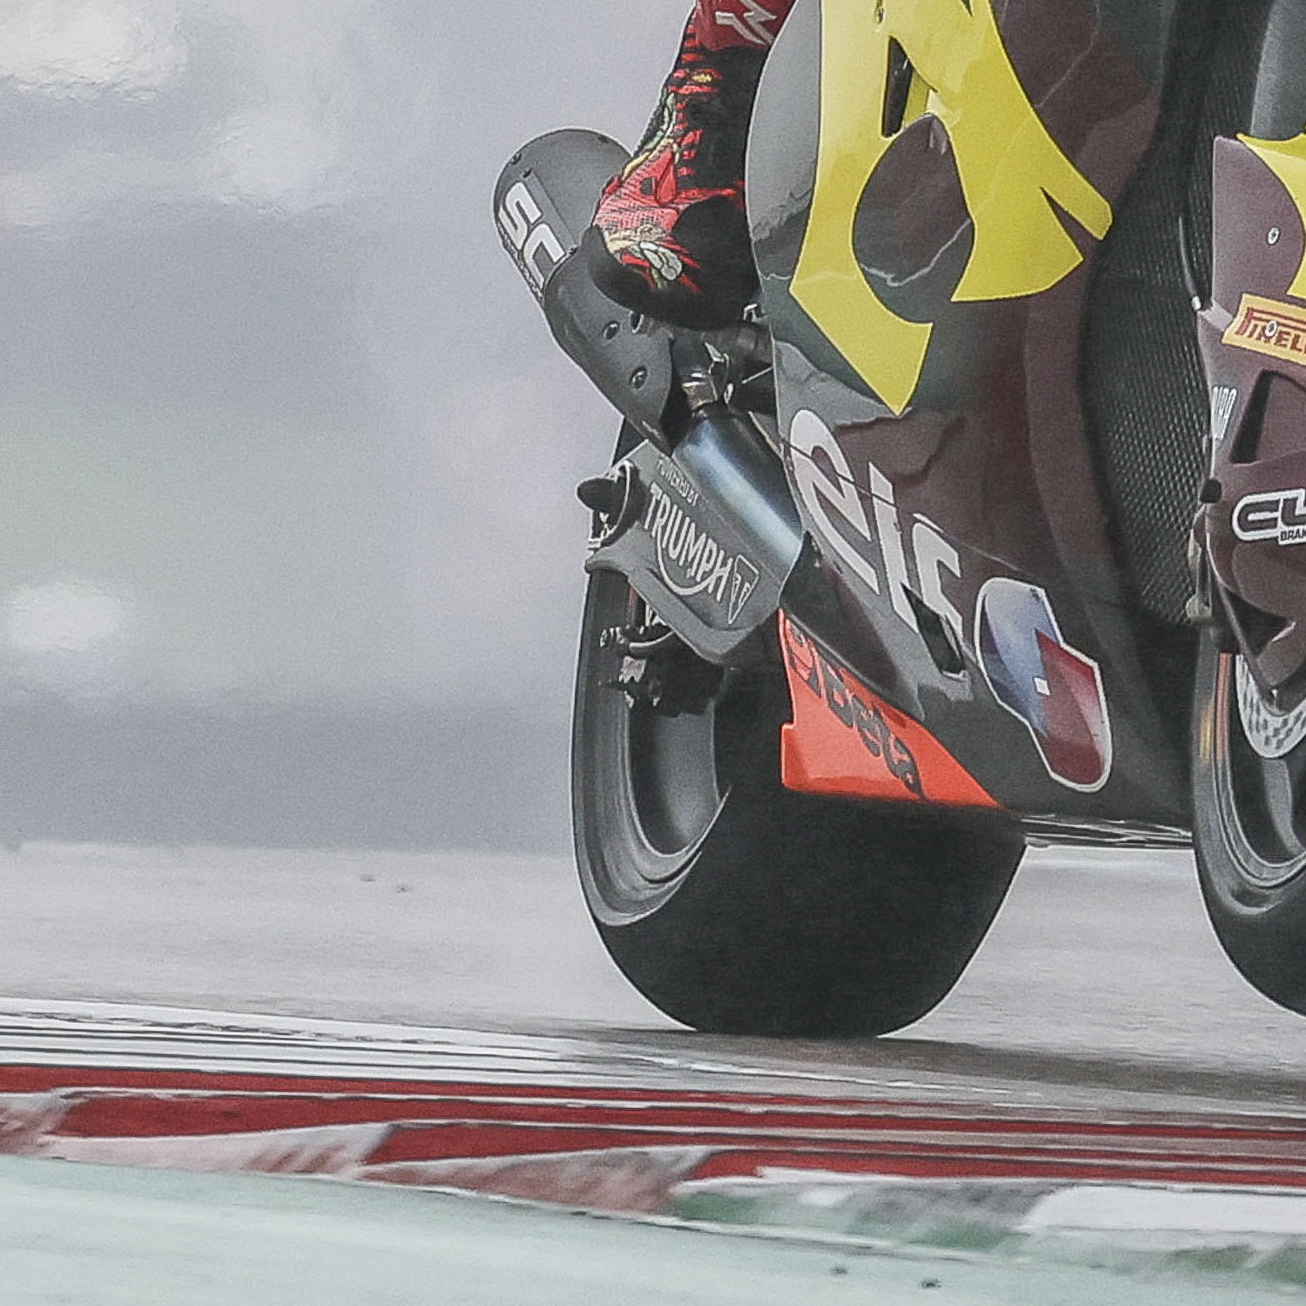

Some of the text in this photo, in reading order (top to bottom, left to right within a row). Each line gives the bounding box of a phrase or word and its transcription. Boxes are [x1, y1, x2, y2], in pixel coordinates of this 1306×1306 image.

[498, 181, 566, 290] SC
[644, 481, 734, 602] TRIUMPH
[789, 409, 964, 639] elf
